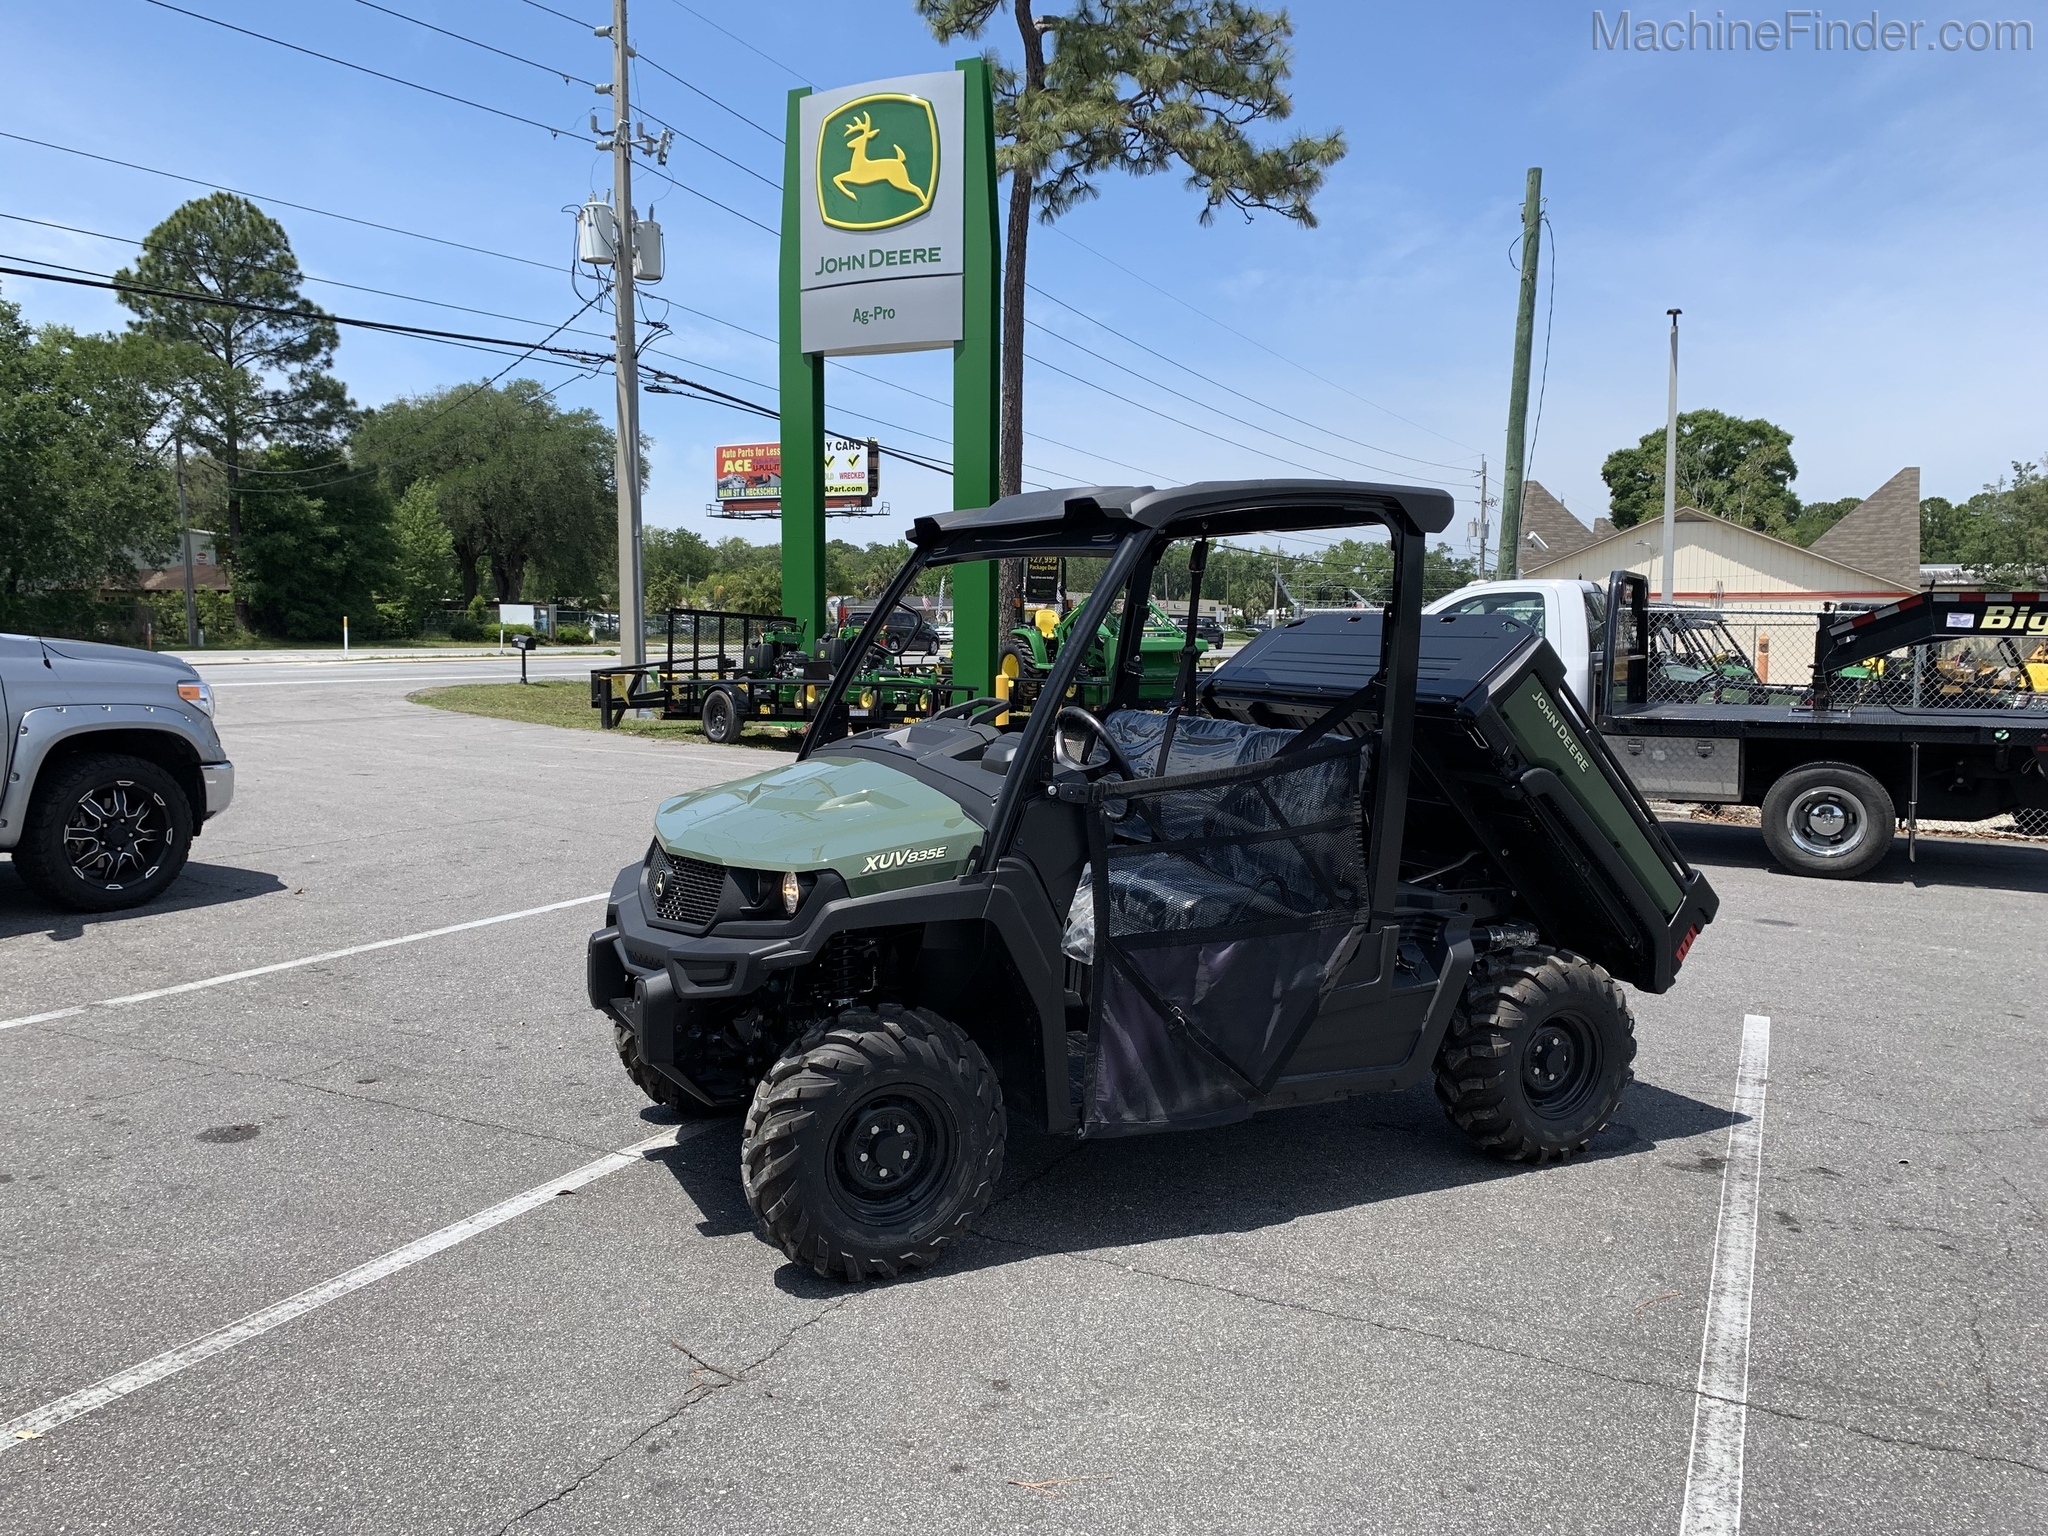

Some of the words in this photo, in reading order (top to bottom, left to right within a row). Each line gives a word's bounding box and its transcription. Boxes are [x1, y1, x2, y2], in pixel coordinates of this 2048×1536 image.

[815, 254, 865, 276] JOHN
[869, 247, 942, 268] DEERE
[853, 306, 896, 325] Ag-Pro
[722, 449, 736, 458] Auto
[737, 448, 754, 457] Parts
[755, 447, 765, 457] for
[766, 446, 781, 456] Less
[723, 459, 752, 473] ACE
[753, 464, 780, 472] U-PULL-IT
[719, 489, 732, 497] MAIN
[733, 488, 740, 496] ST
[745, 487, 777, 496] HECKSCHER
[1532, 692, 1559, 728] JOHN
[1556, 724, 1589, 772] DEERE
